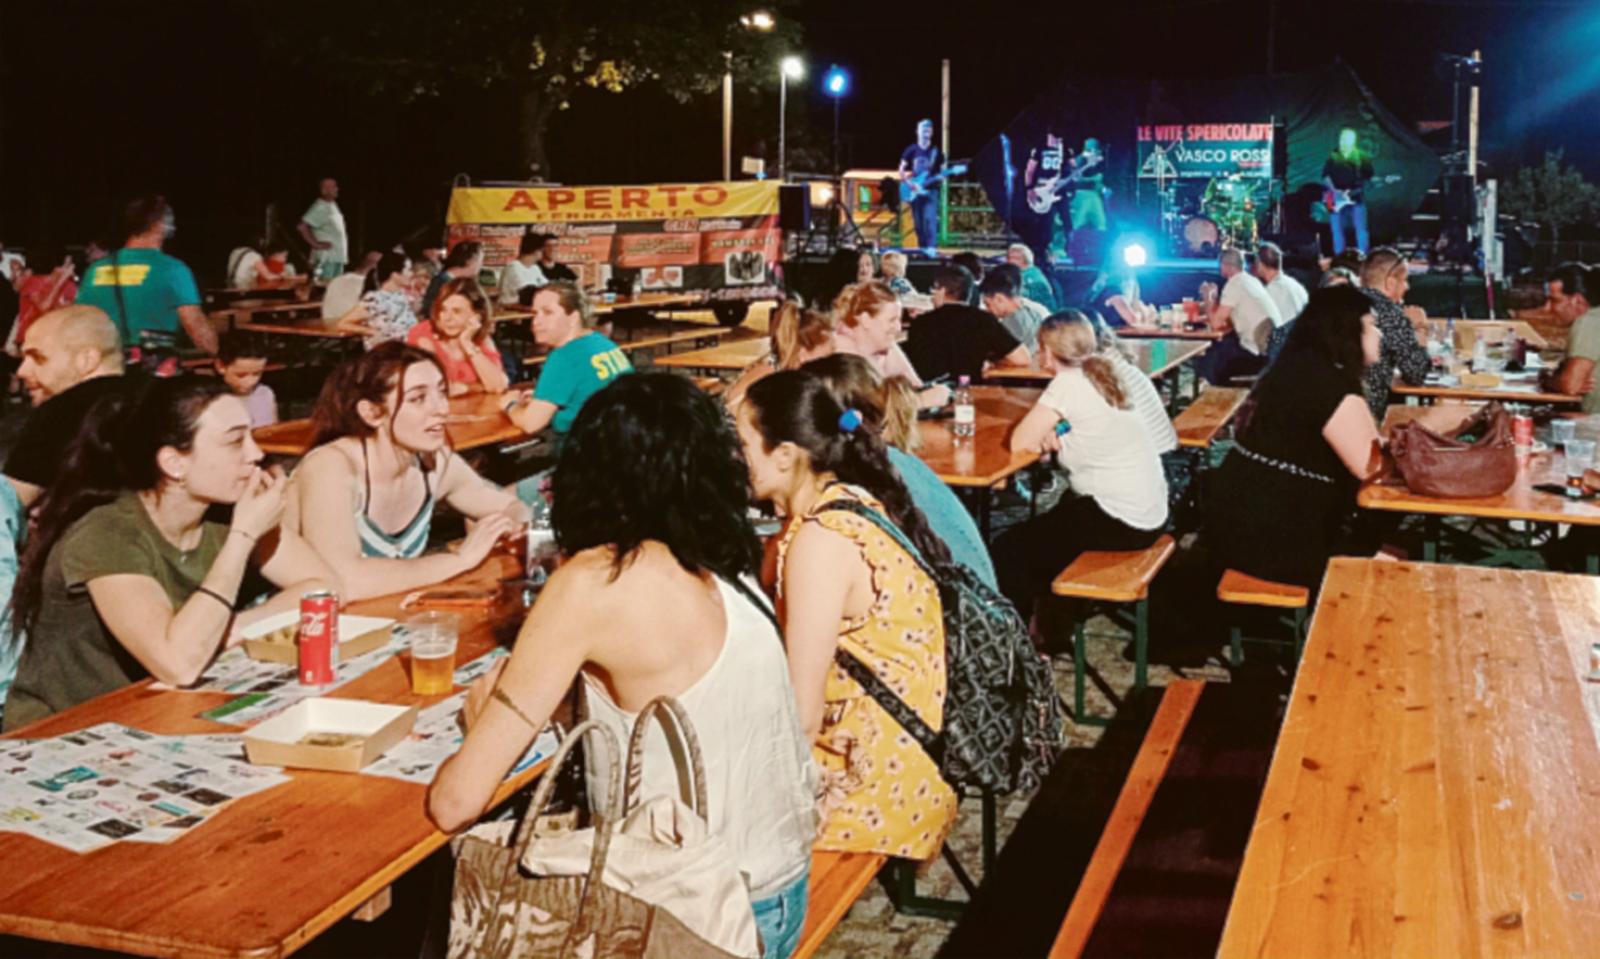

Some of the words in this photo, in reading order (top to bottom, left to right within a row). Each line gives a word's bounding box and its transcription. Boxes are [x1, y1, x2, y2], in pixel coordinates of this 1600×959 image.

[1137, 125, 1152, 141] LE
[1155, 125, 1183, 141] VITE
[1175, 148, 1227, 162] VASCO
[502, 186, 728, 211] APERTO
